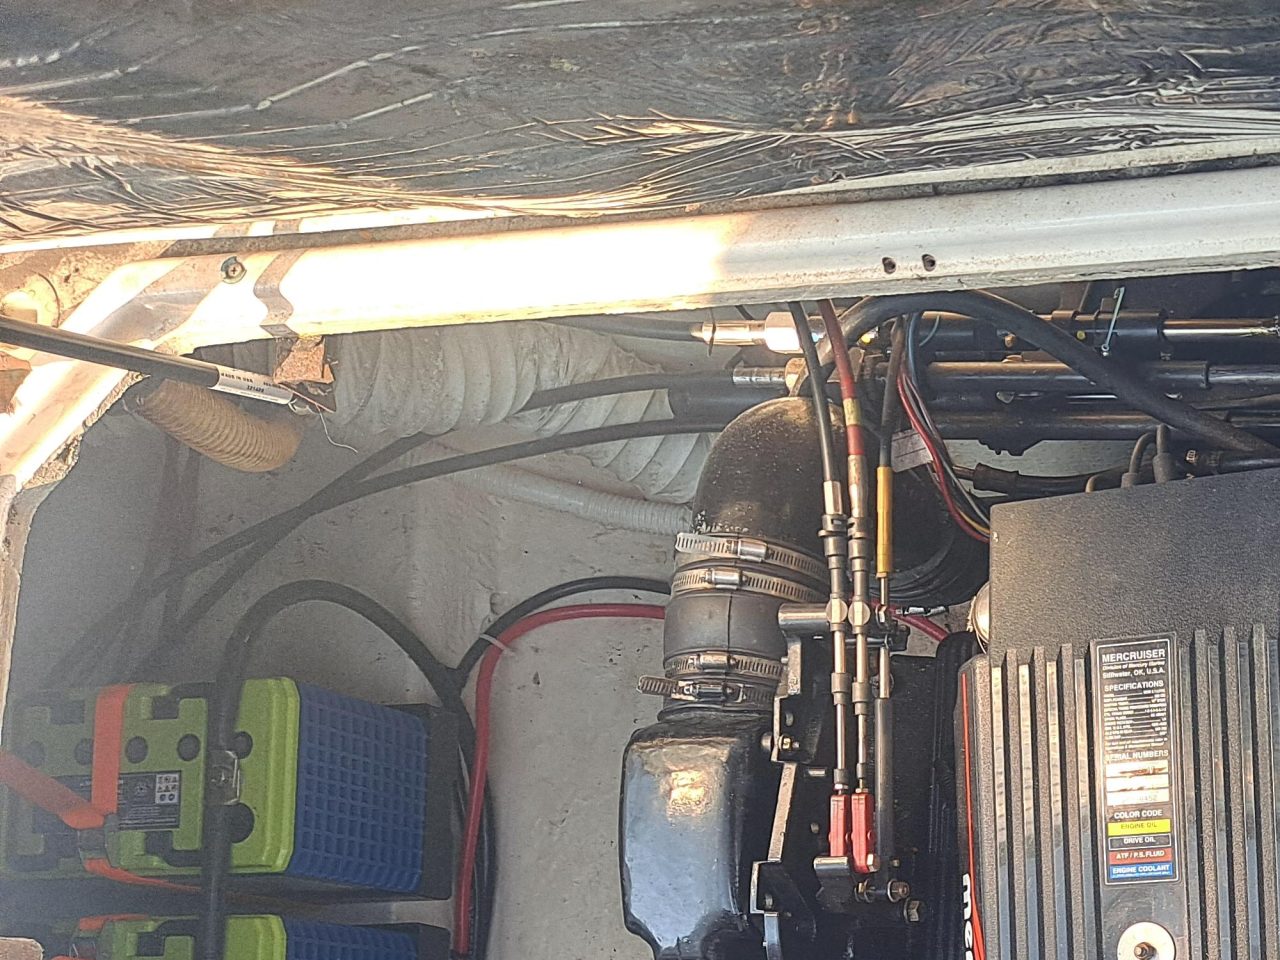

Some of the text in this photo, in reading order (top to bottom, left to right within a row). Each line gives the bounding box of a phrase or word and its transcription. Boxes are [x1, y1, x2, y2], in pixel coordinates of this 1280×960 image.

[1102, 649, 1166, 663] MERCRUISER
[1104, 680, 1164, 692] SPECIFICATIONS
[1132, 749, 1169, 760] NUMBERS
[1114, 809, 1163, 819] COLOR CODE
[1120, 822, 1144, 830] ENGINE
[1116, 852, 1129, 860] ATF
[1112, 865, 1137, 875] ENGINE
[1137, 863, 1170, 873] COOLANT
